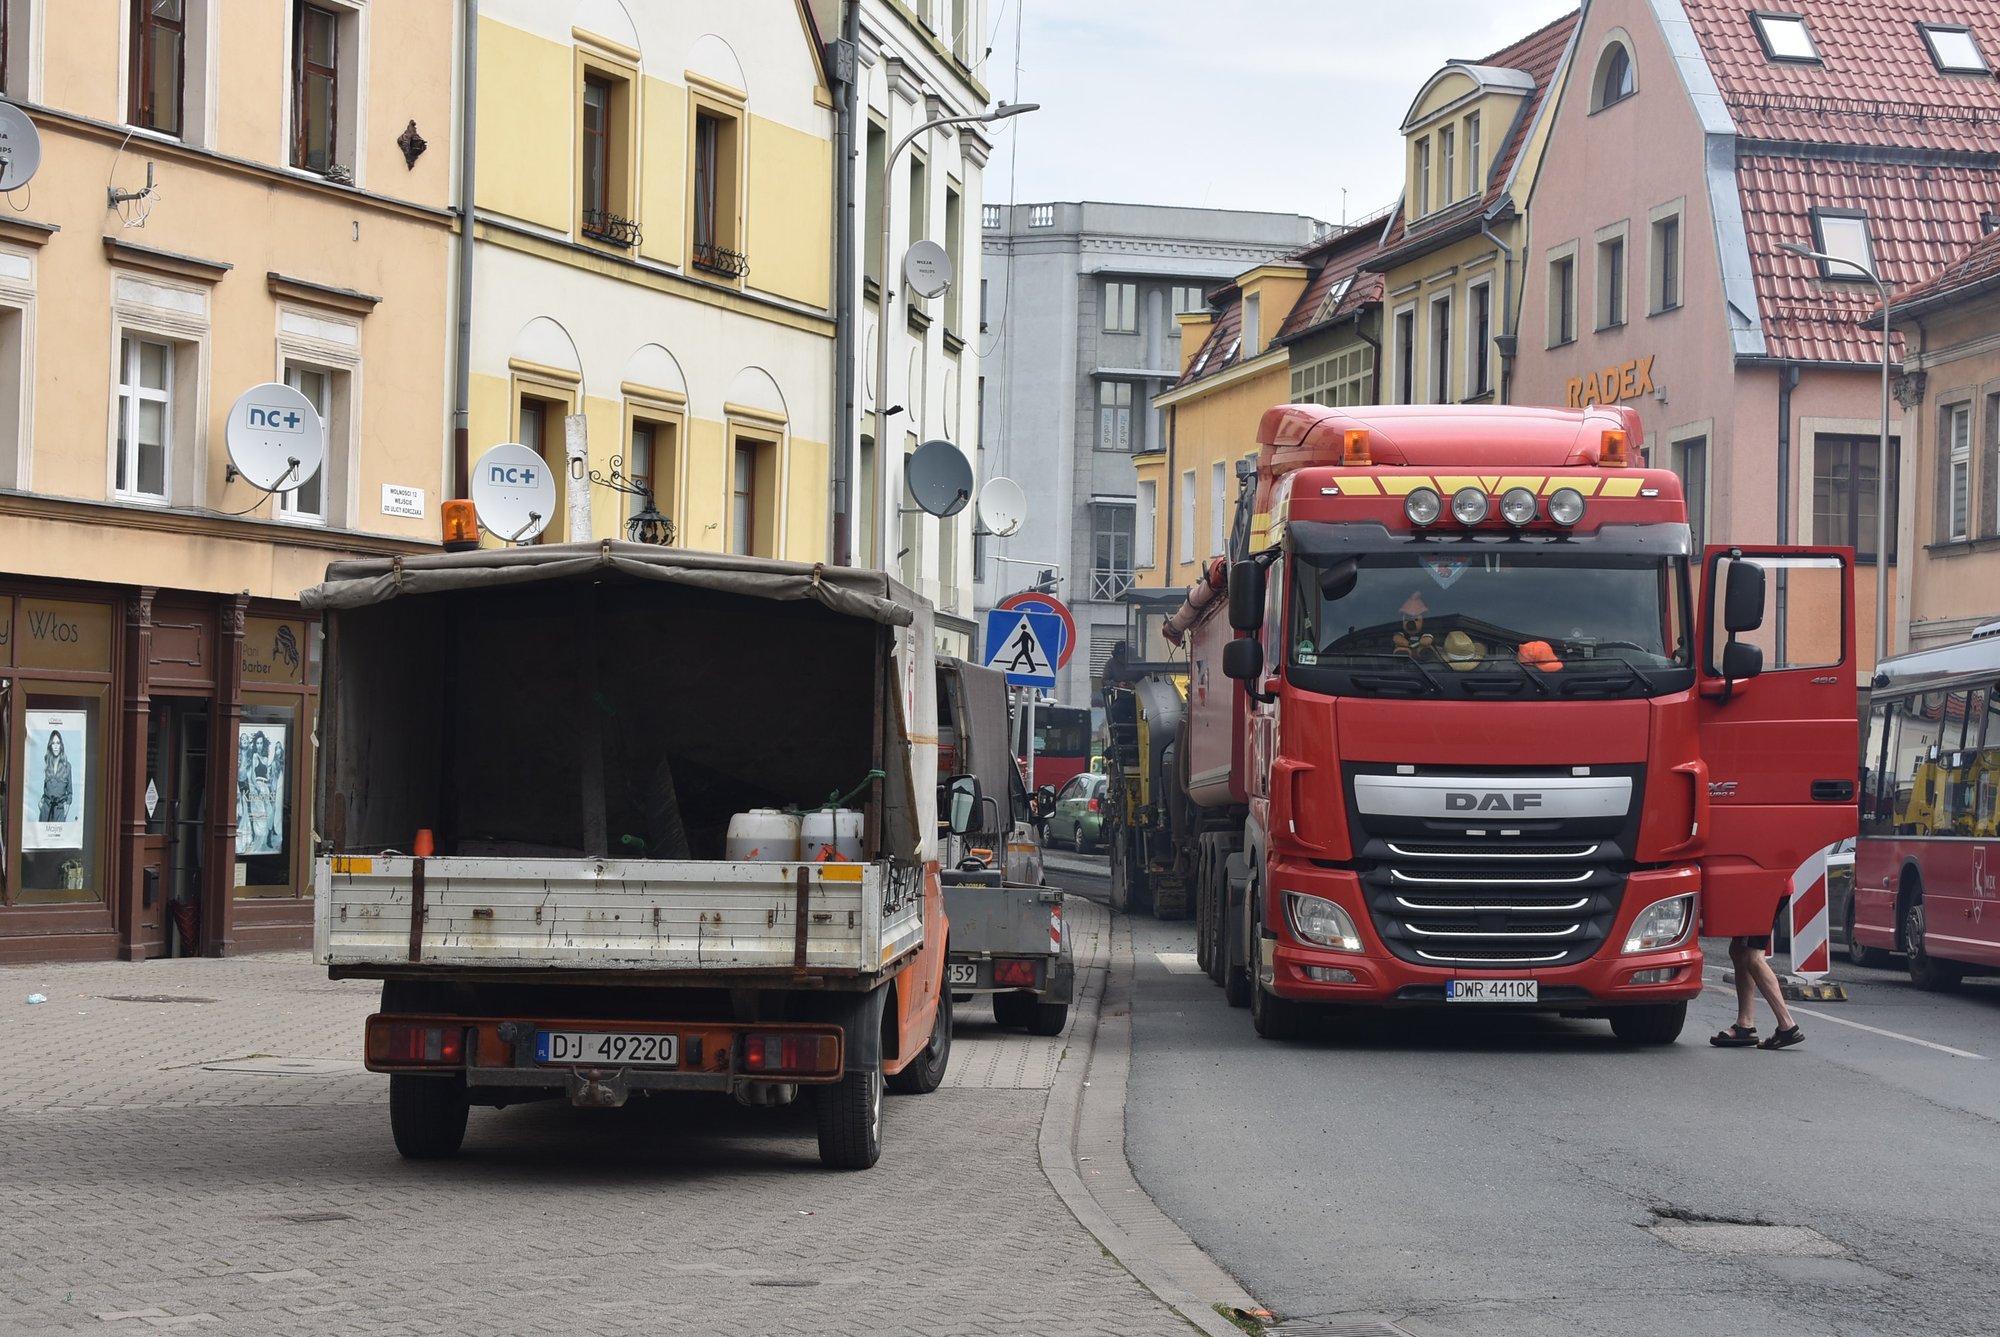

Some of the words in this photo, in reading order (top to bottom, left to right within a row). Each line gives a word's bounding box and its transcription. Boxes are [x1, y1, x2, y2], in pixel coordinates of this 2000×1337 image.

[1567, 353, 1655, 408] RADEX
[250, 408, 300, 428] nc+
[491, 467, 535, 484] nc+
[27, 610, 79, 643] Włos
[242, 659, 271, 674] Barber
[1708, 781, 1738, 791] XF
[1446, 793, 1542, 811] DAF
[1455, 982, 1484, 998] DWR
[1489, 982, 1535, 998] 4410K
[553, 1035, 583, 1059] DJ
[598, 1036, 672, 1061] 49220
